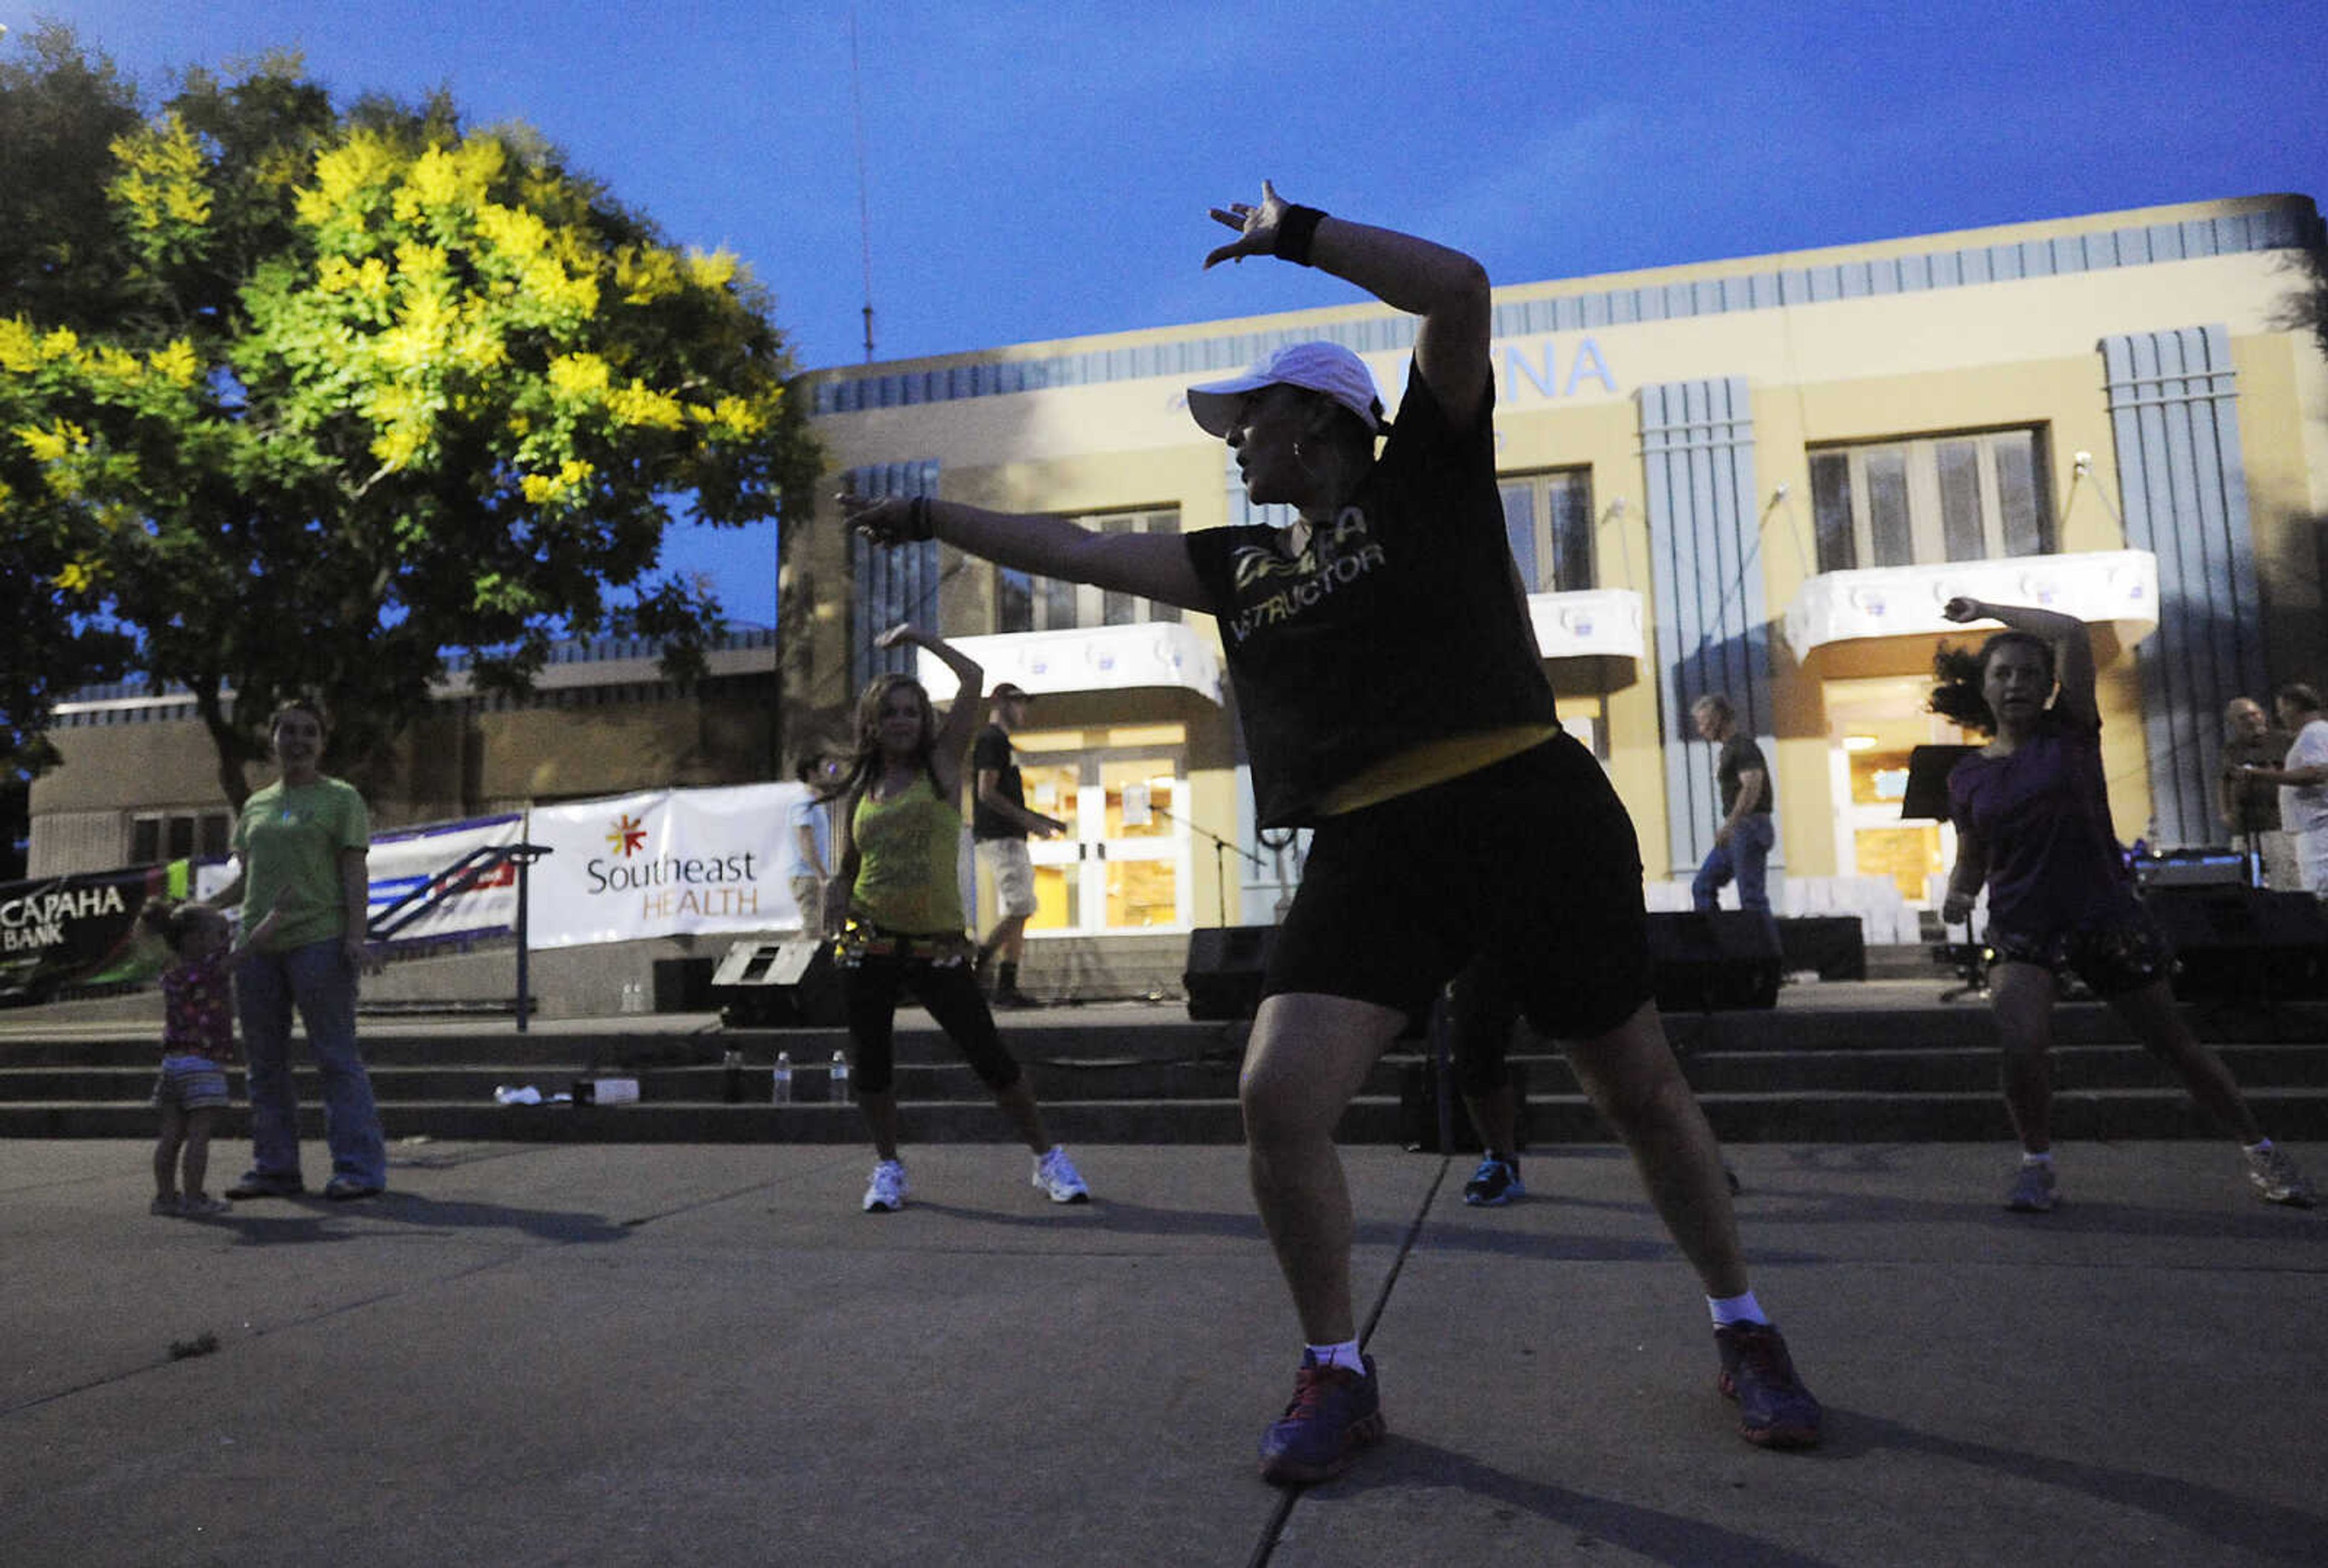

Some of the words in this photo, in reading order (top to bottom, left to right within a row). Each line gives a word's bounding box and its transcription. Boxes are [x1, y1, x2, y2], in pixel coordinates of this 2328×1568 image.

[586, 850, 758, 895] Southeast
[0, 885, 125, 927] CAPAHA
[643, 888, 758, 921] HEALTH
[4, 922, 64, 951] BANK
